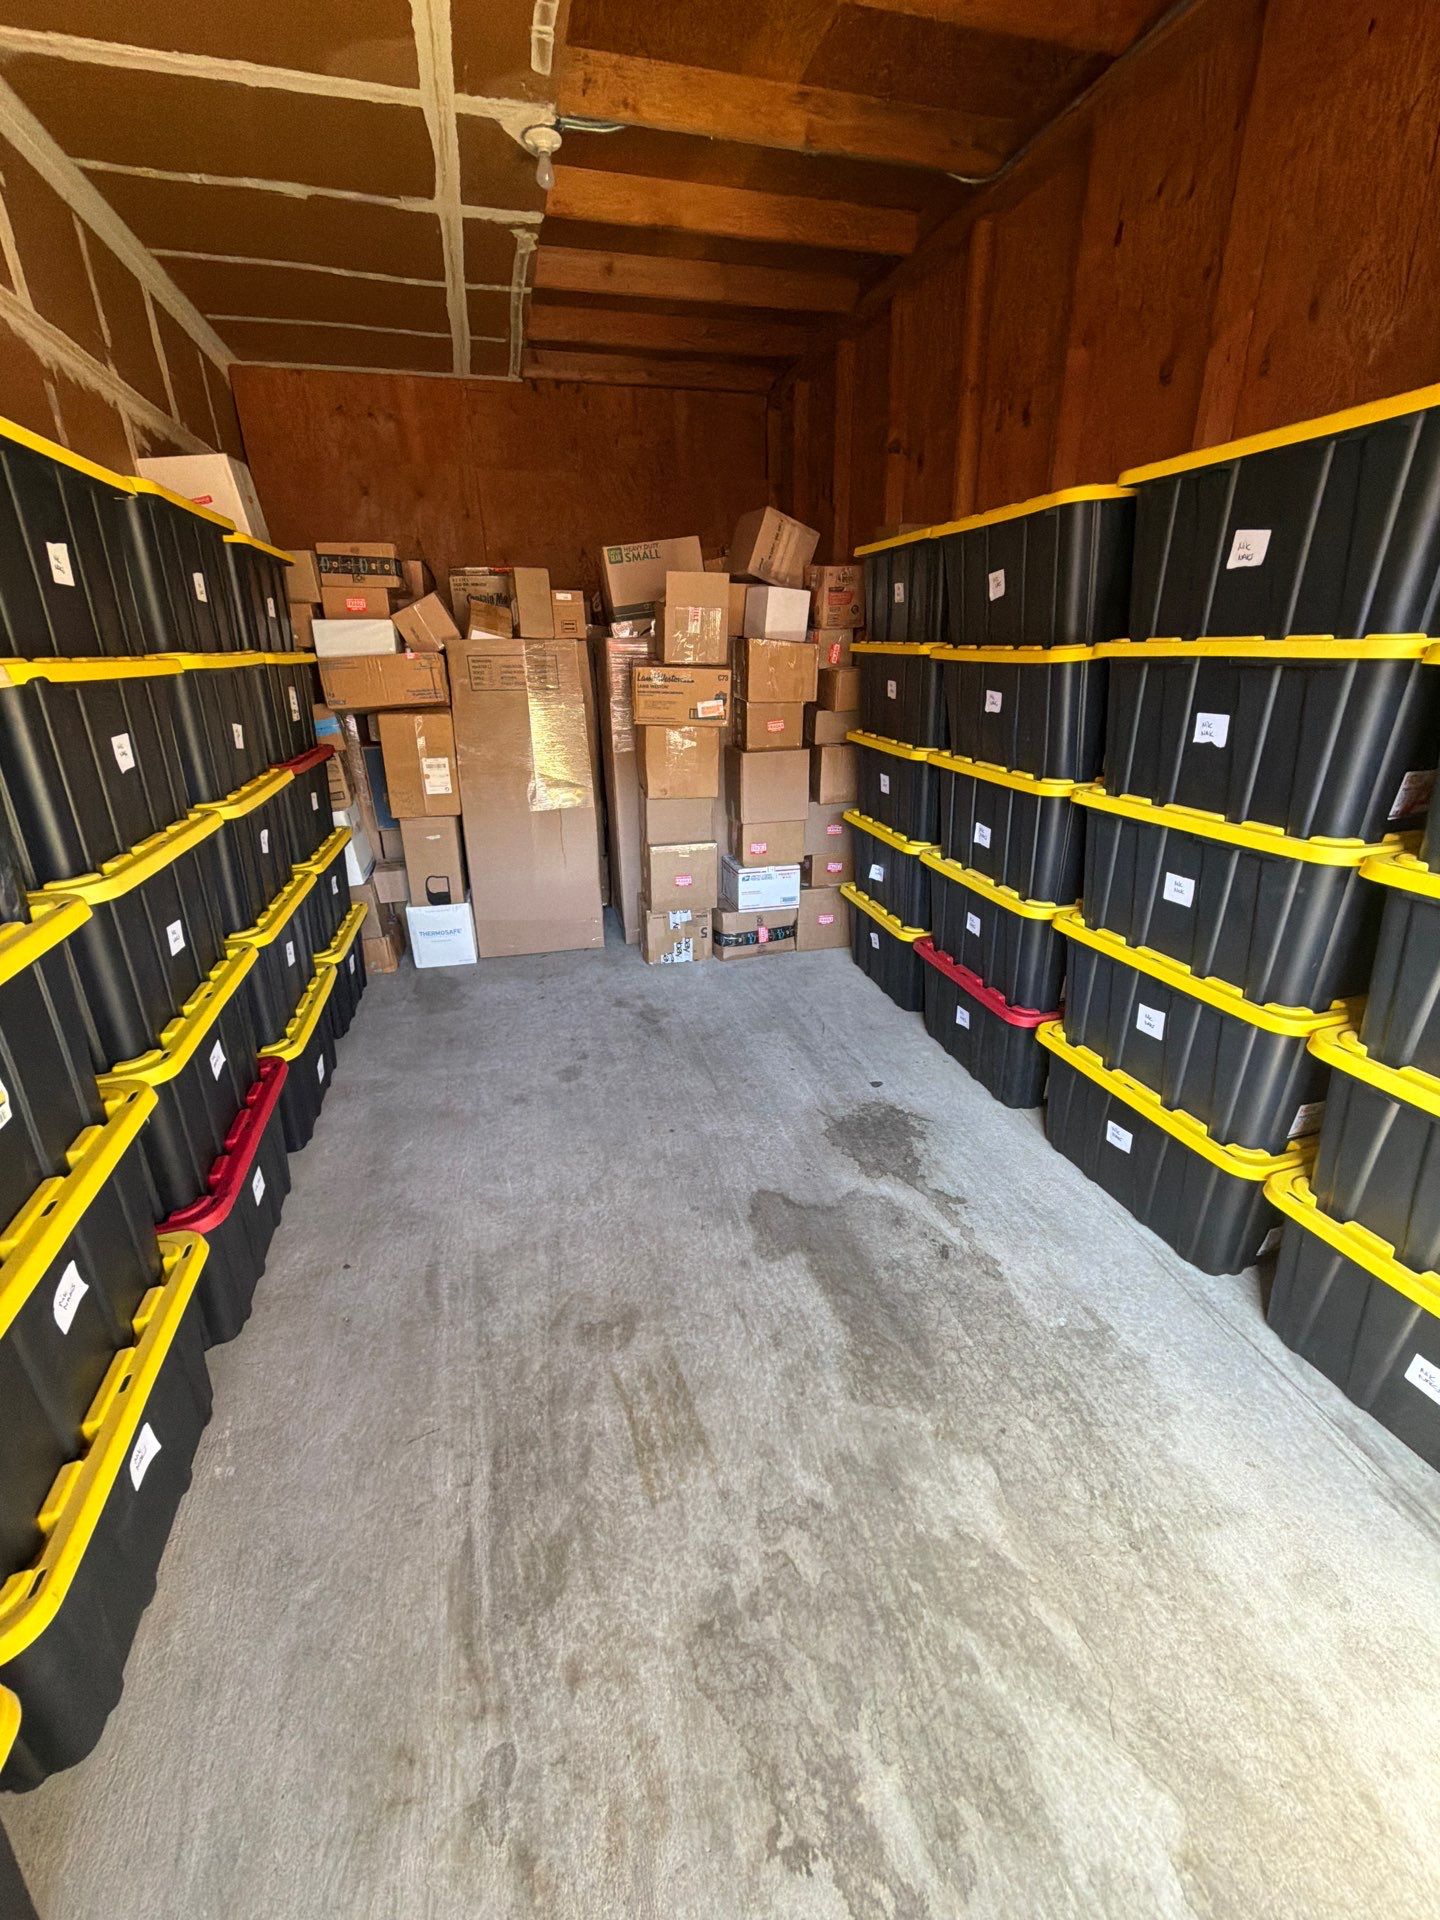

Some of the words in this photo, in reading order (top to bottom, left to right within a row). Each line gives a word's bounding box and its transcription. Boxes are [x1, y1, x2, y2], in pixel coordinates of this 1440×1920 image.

[624, 545, 642, 553] HEAVY
[644, 542, 660, 550] DUTY
[624, 549, 661, 562] SMALL
[717, 674, 729, 682] C73
